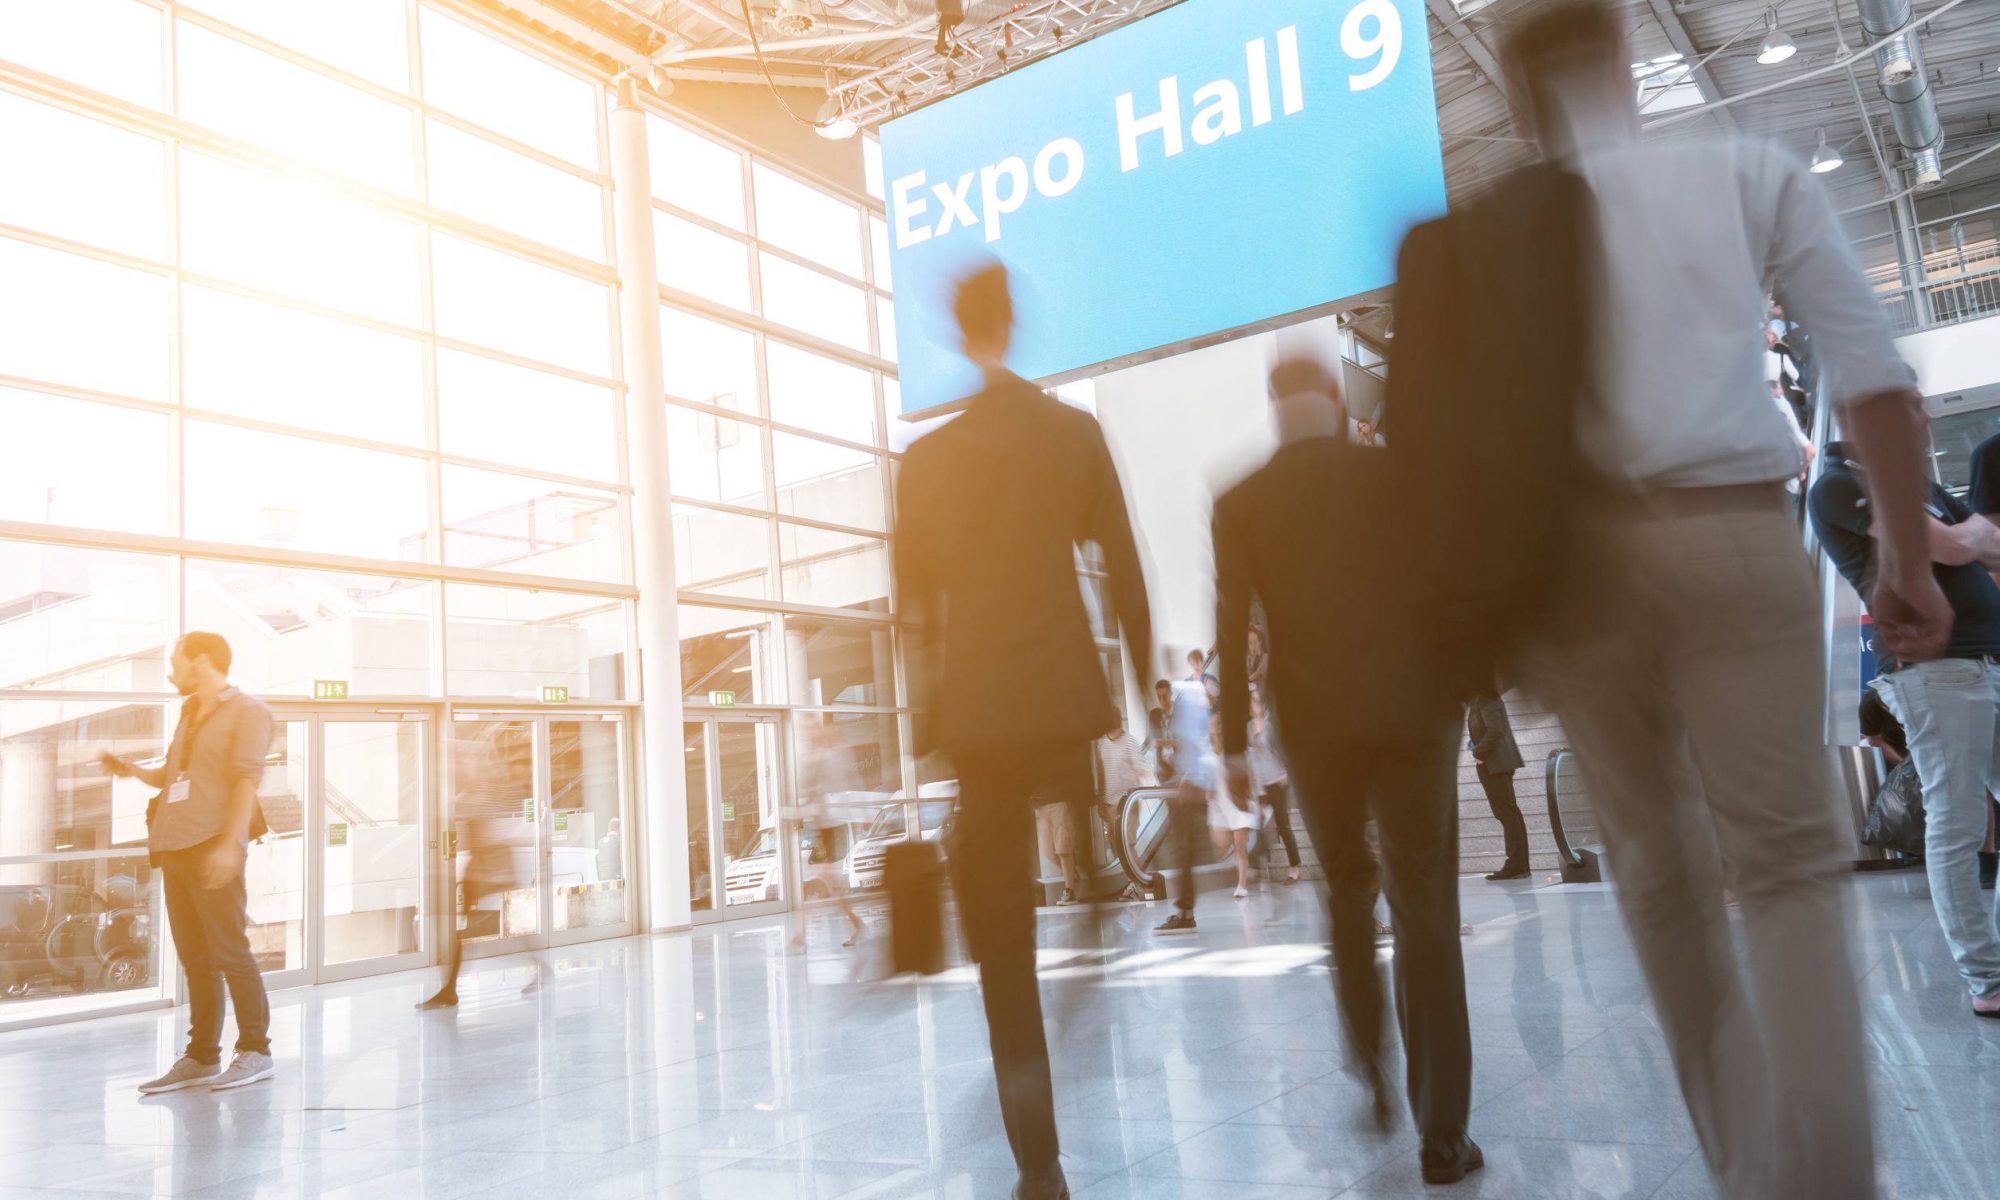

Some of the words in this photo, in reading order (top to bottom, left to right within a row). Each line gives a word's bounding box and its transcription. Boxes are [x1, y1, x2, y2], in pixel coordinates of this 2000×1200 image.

[891, 137, 1085, 249] Expo
[1115, 25, 1304, 173] Hall
[1339, 0, 1402, 92] 9
